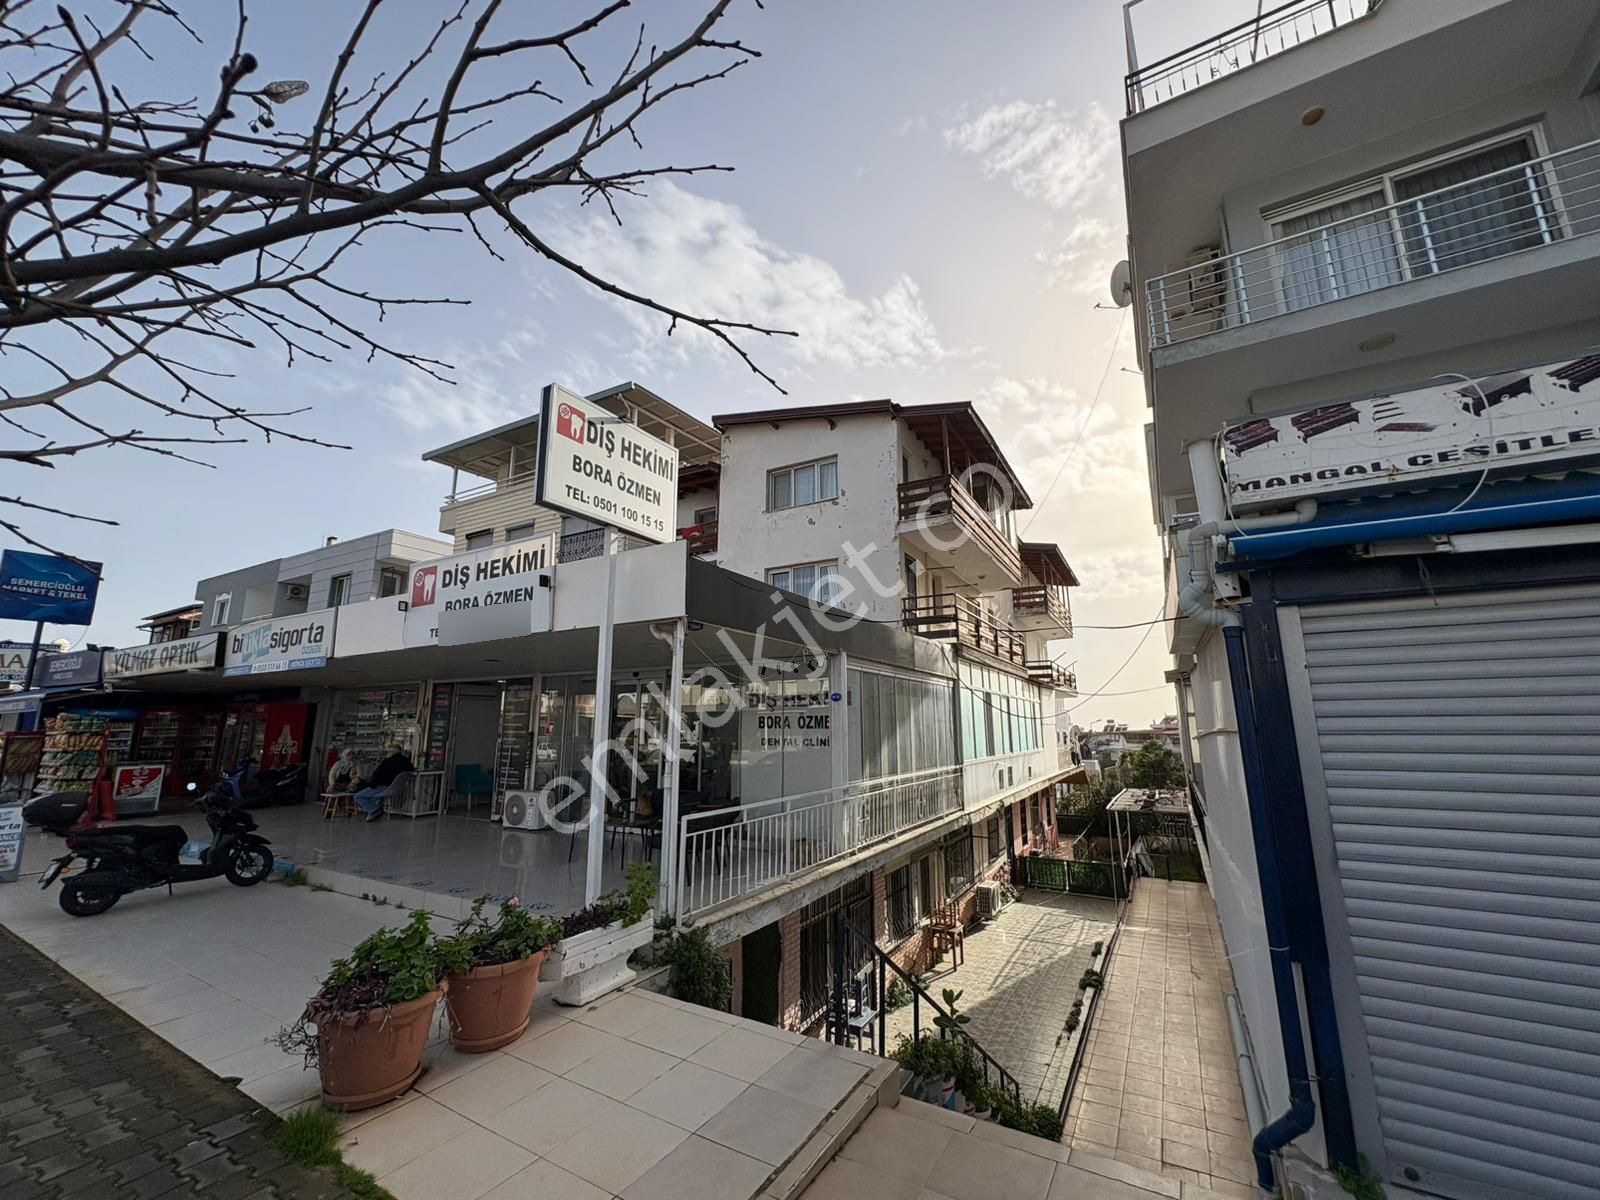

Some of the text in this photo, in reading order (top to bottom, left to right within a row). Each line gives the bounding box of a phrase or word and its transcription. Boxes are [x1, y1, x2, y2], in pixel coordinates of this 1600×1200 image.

[587, 420, 674, 482] DİŞ HEKİMİ
[572, 454, 661, 506] BORA ÖZMEN
[565, 484, 664, 532] TEL: 0501 100 15 15
[441, 544, 545, 590] DİŞ HEKİMİ
[57, 590, 88, 600] TEKEL
[445, 586, 533, 611] BORA ÖZMEN
[115, 648, 157, 673] YILMAZ
[758, 714, 792, 729] BORA
